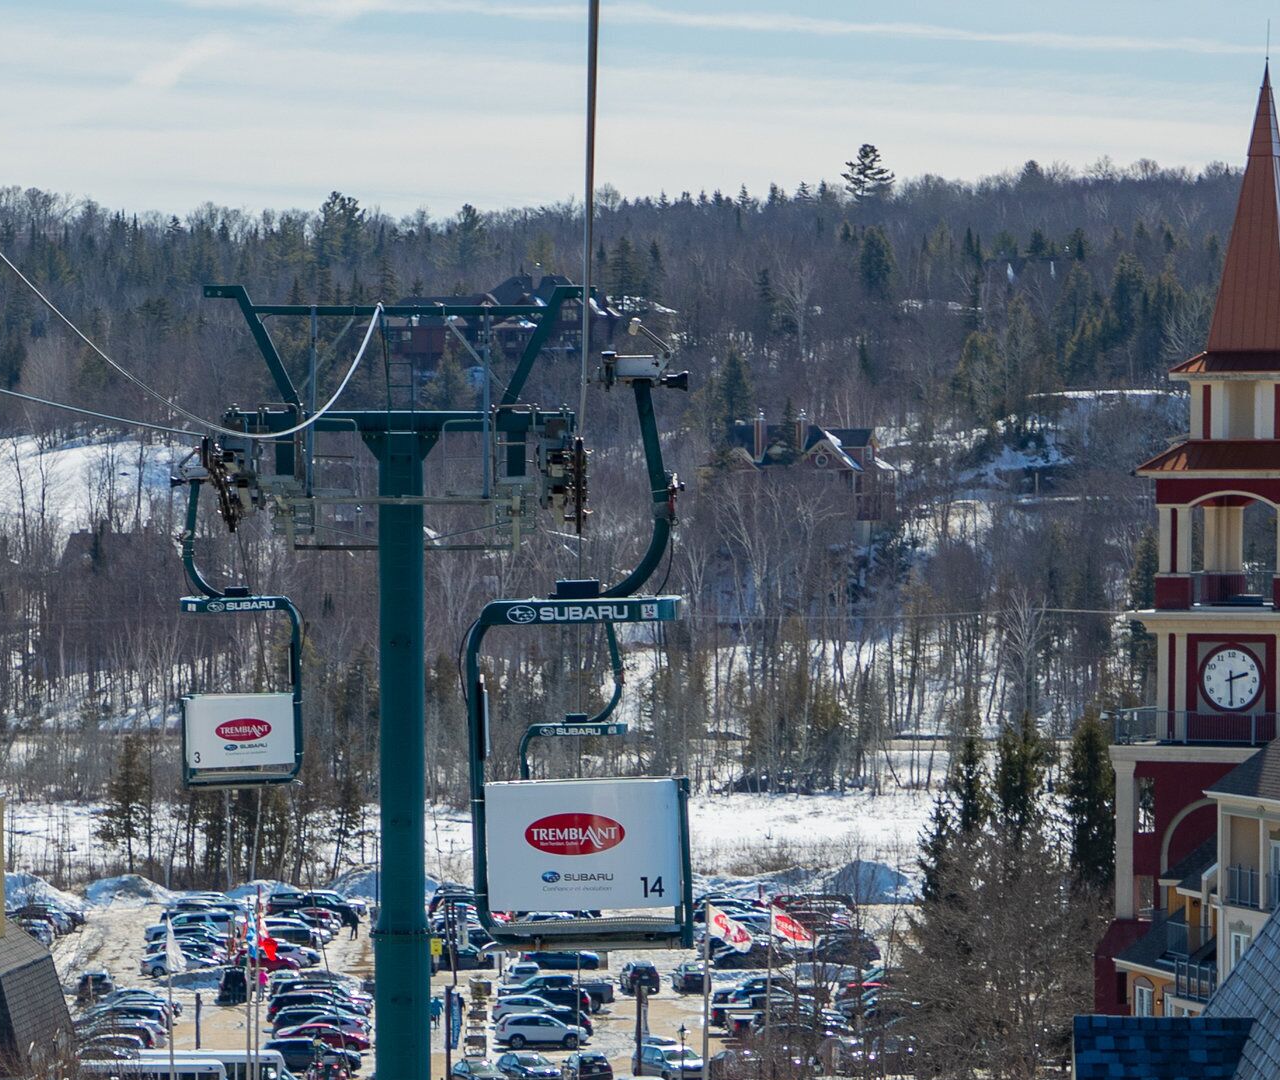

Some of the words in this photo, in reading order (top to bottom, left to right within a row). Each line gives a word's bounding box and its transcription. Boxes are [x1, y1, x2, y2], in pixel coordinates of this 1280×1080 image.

[226, 600, 276, 610] SUBARU
[539, 605, 628, 621] SUBARU
[220, 724, 269, 738] TREMBLANT
[555, 727, 602, 735] SUBARU
[193, 751, 201, 763] 3
[531, 825, 618, 849] TREMBLANT
[564, 873, 614, 882] SUBARU
[640, 876, 665, 898] 14
